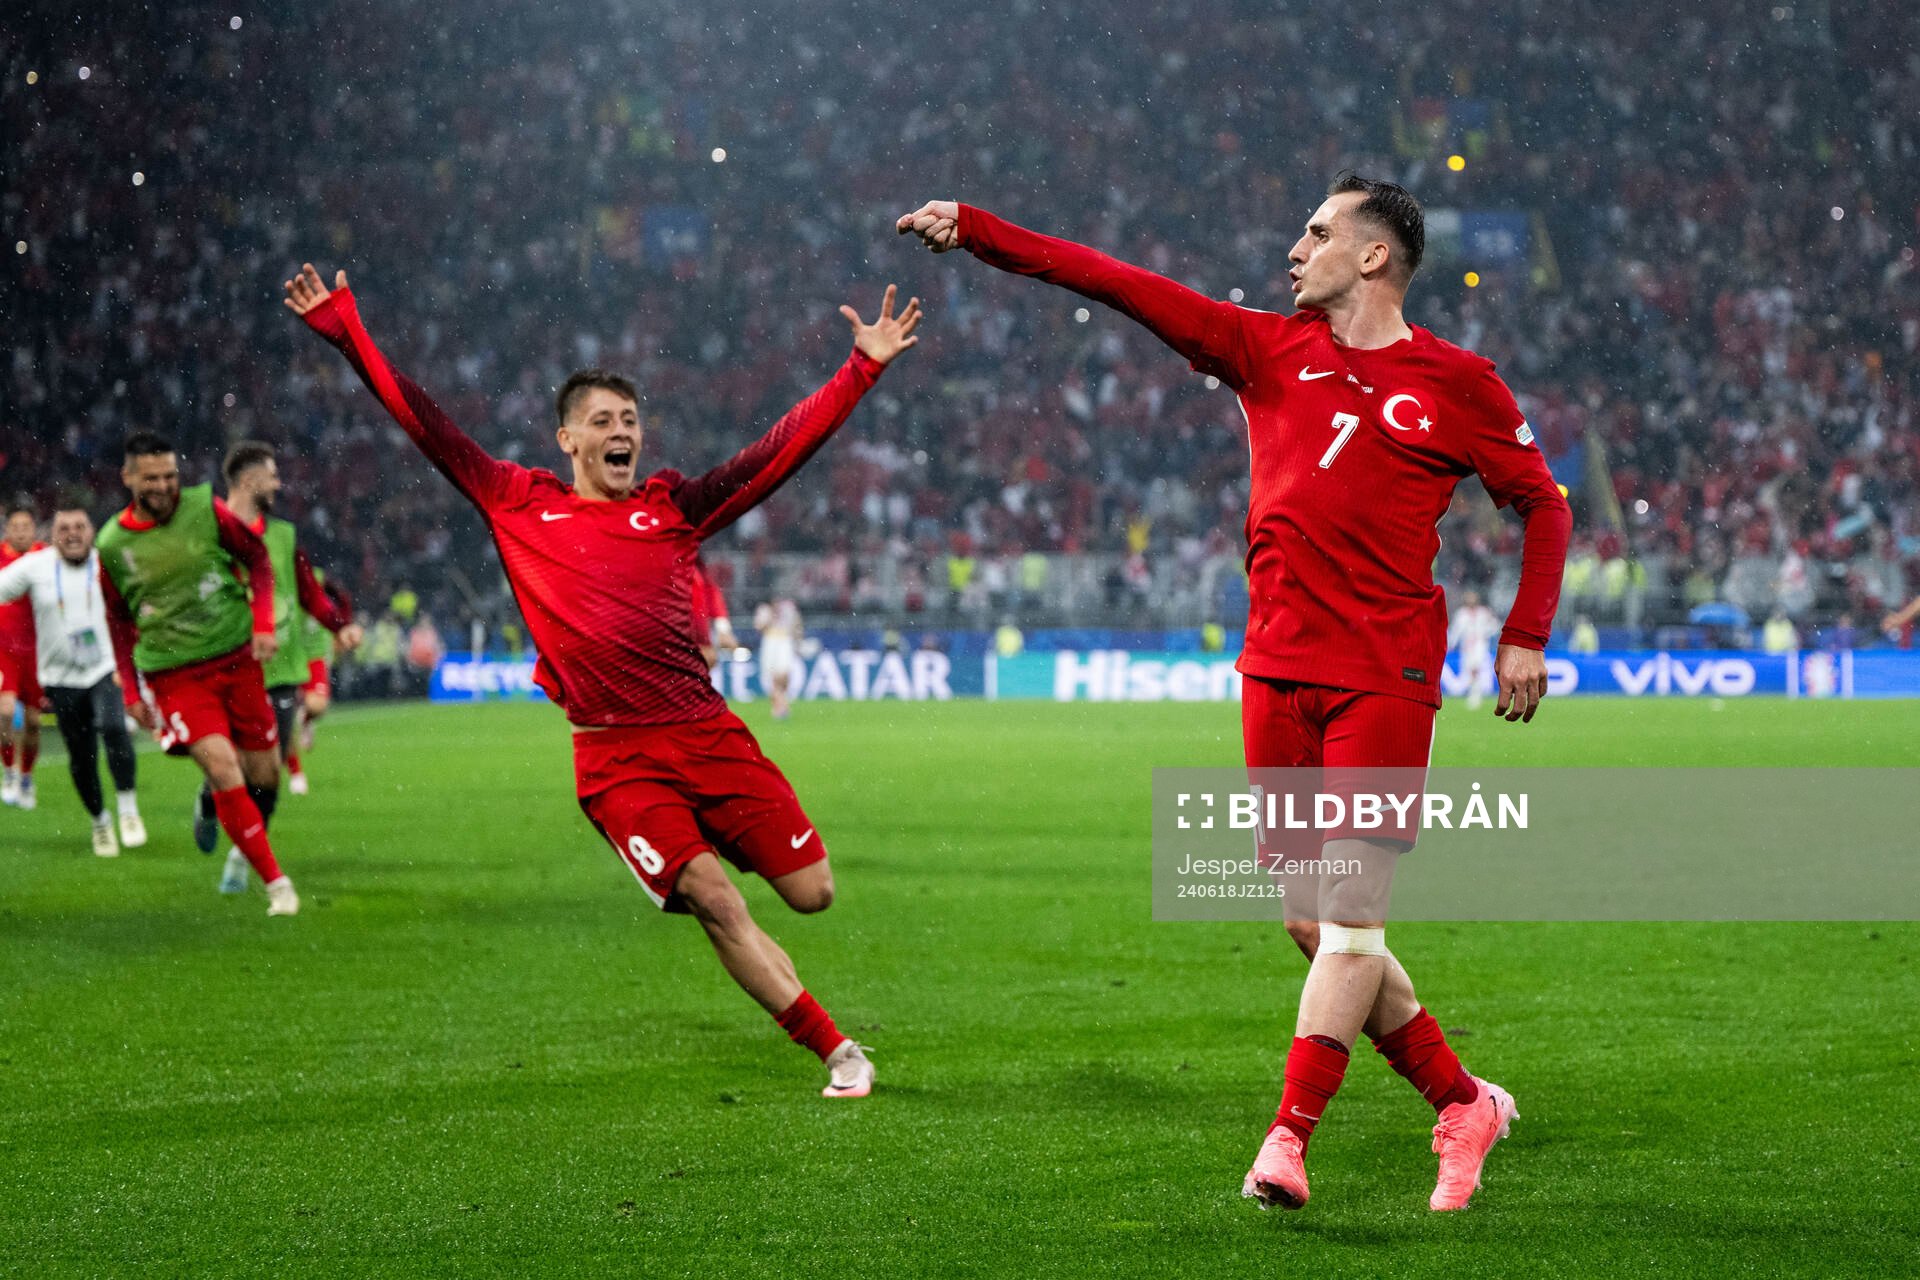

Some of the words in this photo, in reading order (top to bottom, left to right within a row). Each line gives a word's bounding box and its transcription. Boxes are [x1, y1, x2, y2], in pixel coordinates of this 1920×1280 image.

[1318, 411, 1360, 469] 7
[1054, 650, 1246, 701] Hisen
[628, 835, 666, 876] 8
